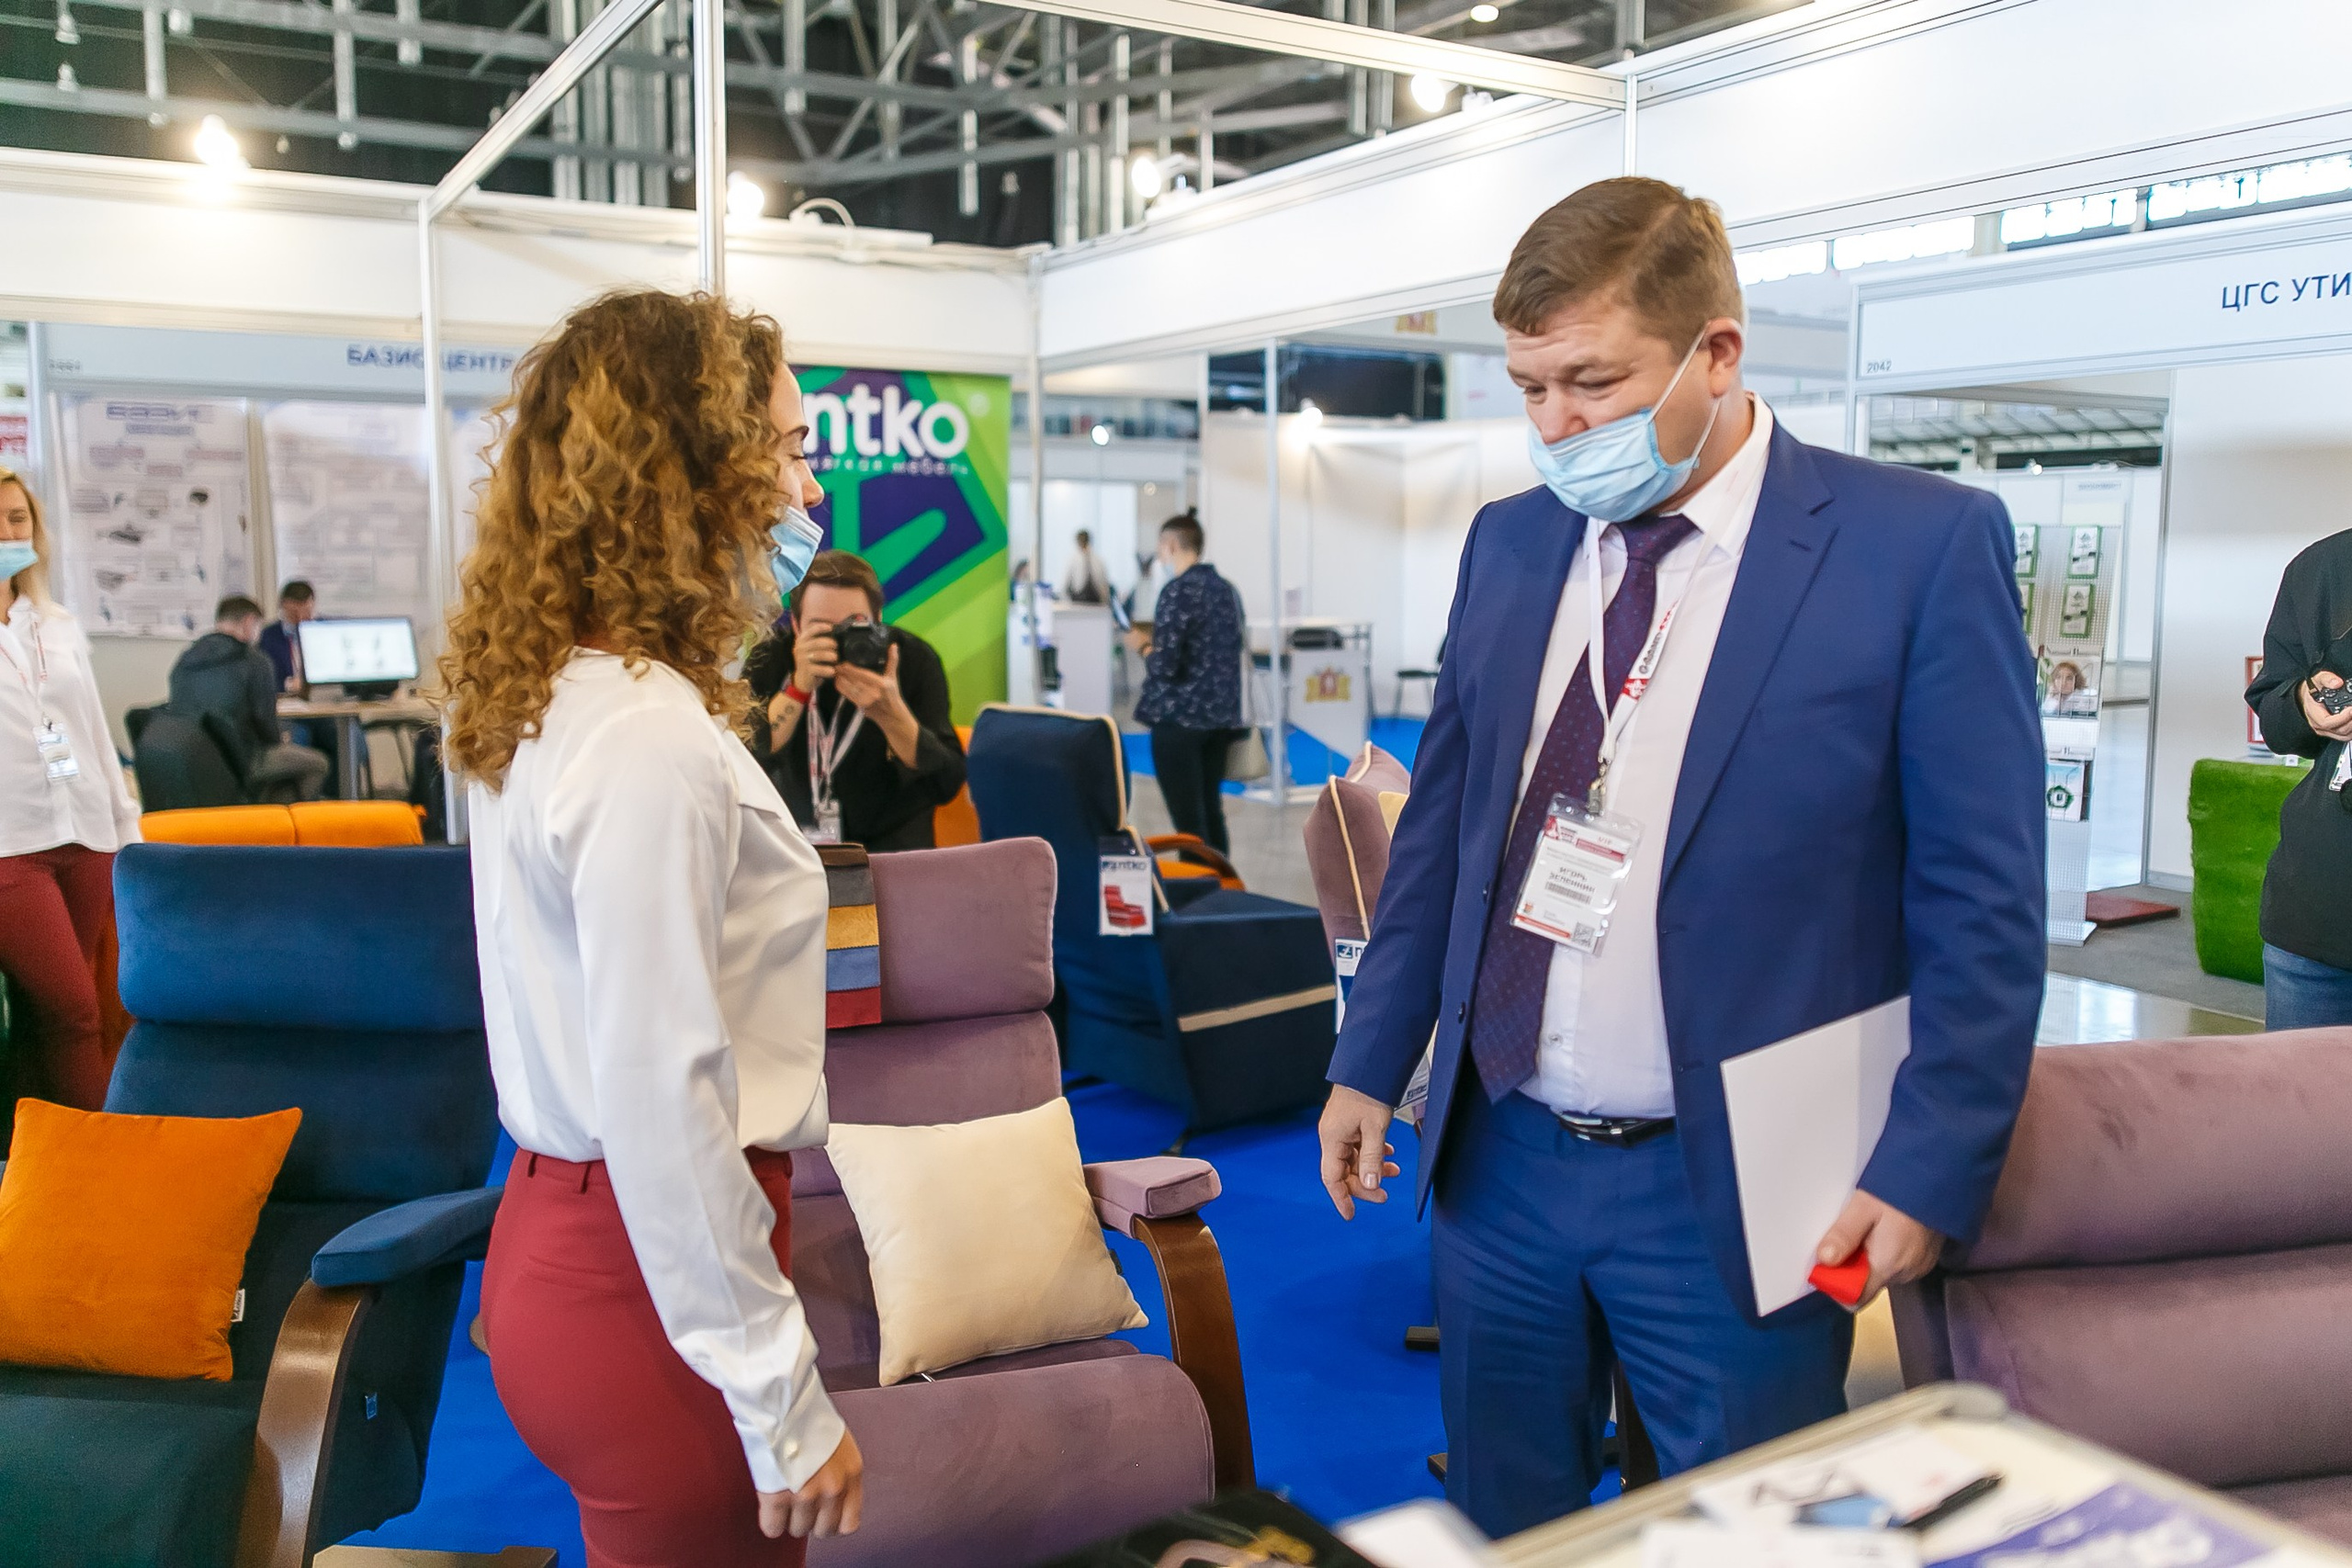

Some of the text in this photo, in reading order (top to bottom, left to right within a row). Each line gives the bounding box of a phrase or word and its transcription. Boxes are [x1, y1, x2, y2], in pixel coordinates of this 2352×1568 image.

[2222, 271, 2352, 312] ЦГС УТИ
[801, 383, 969, 459] ntko
